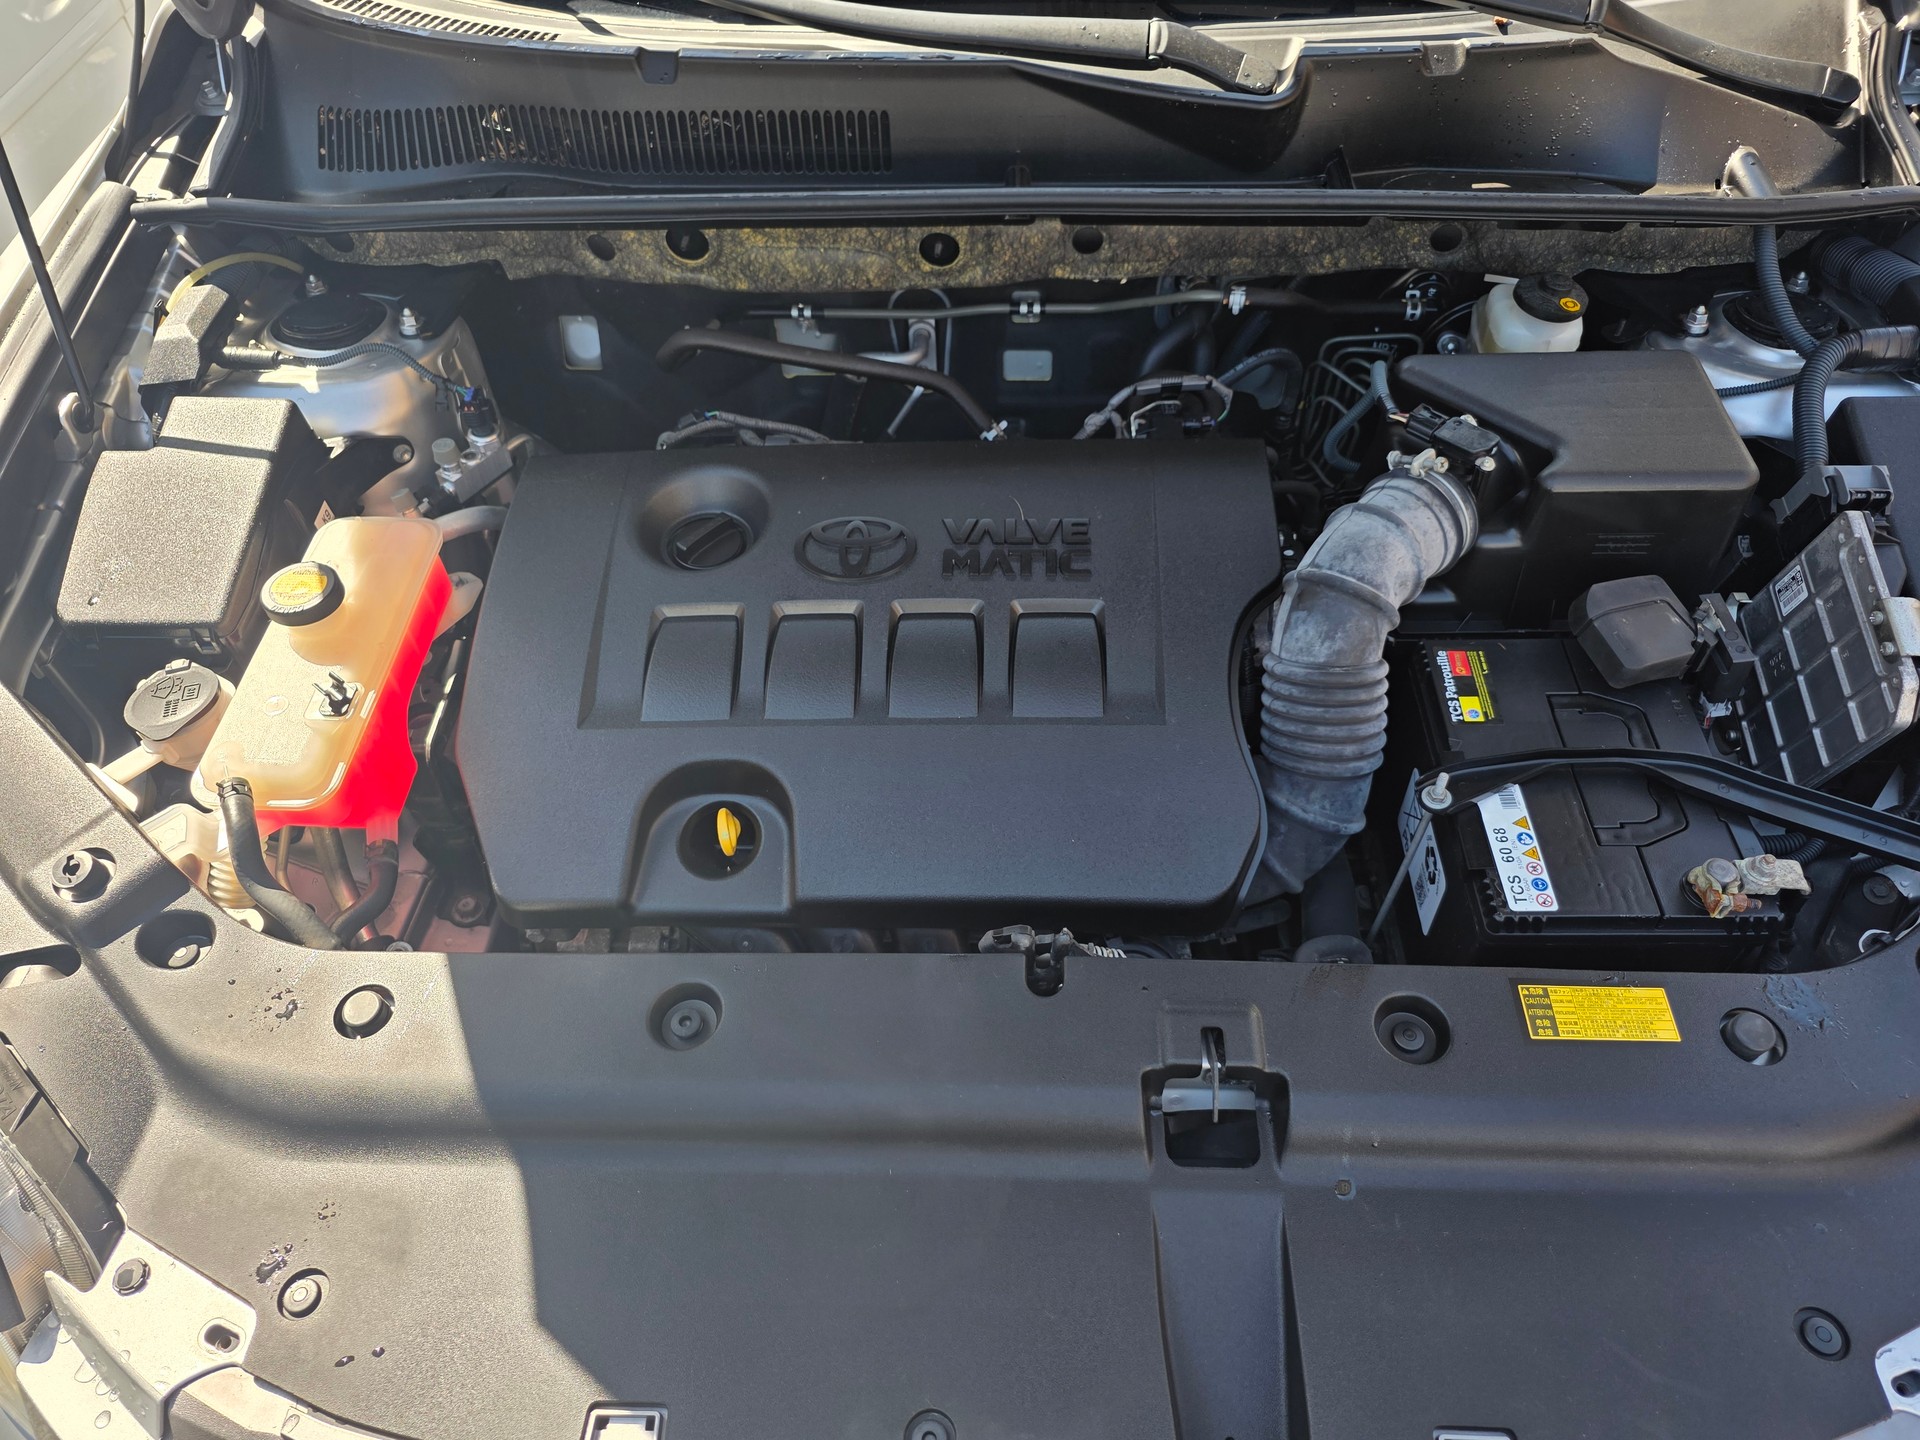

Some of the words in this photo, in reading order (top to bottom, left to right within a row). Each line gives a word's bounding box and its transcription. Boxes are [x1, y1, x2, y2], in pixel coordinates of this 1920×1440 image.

[942, 518, 1091, 546] VALVE
[942, 548, 1092, 578] MATIC
[1436, 650, 1459, 699] Patrouille
[1447, 700, 1464, 722] TCS
[1492, 827, 1509, 843] 68
[1498, 847, 1515, 863] 60
[1507, 874, 1528, 904] TCS
[1525, 997, 1551, 1005] CAUTION
[1528, 1008, 1554, 1016] ATTENTION
